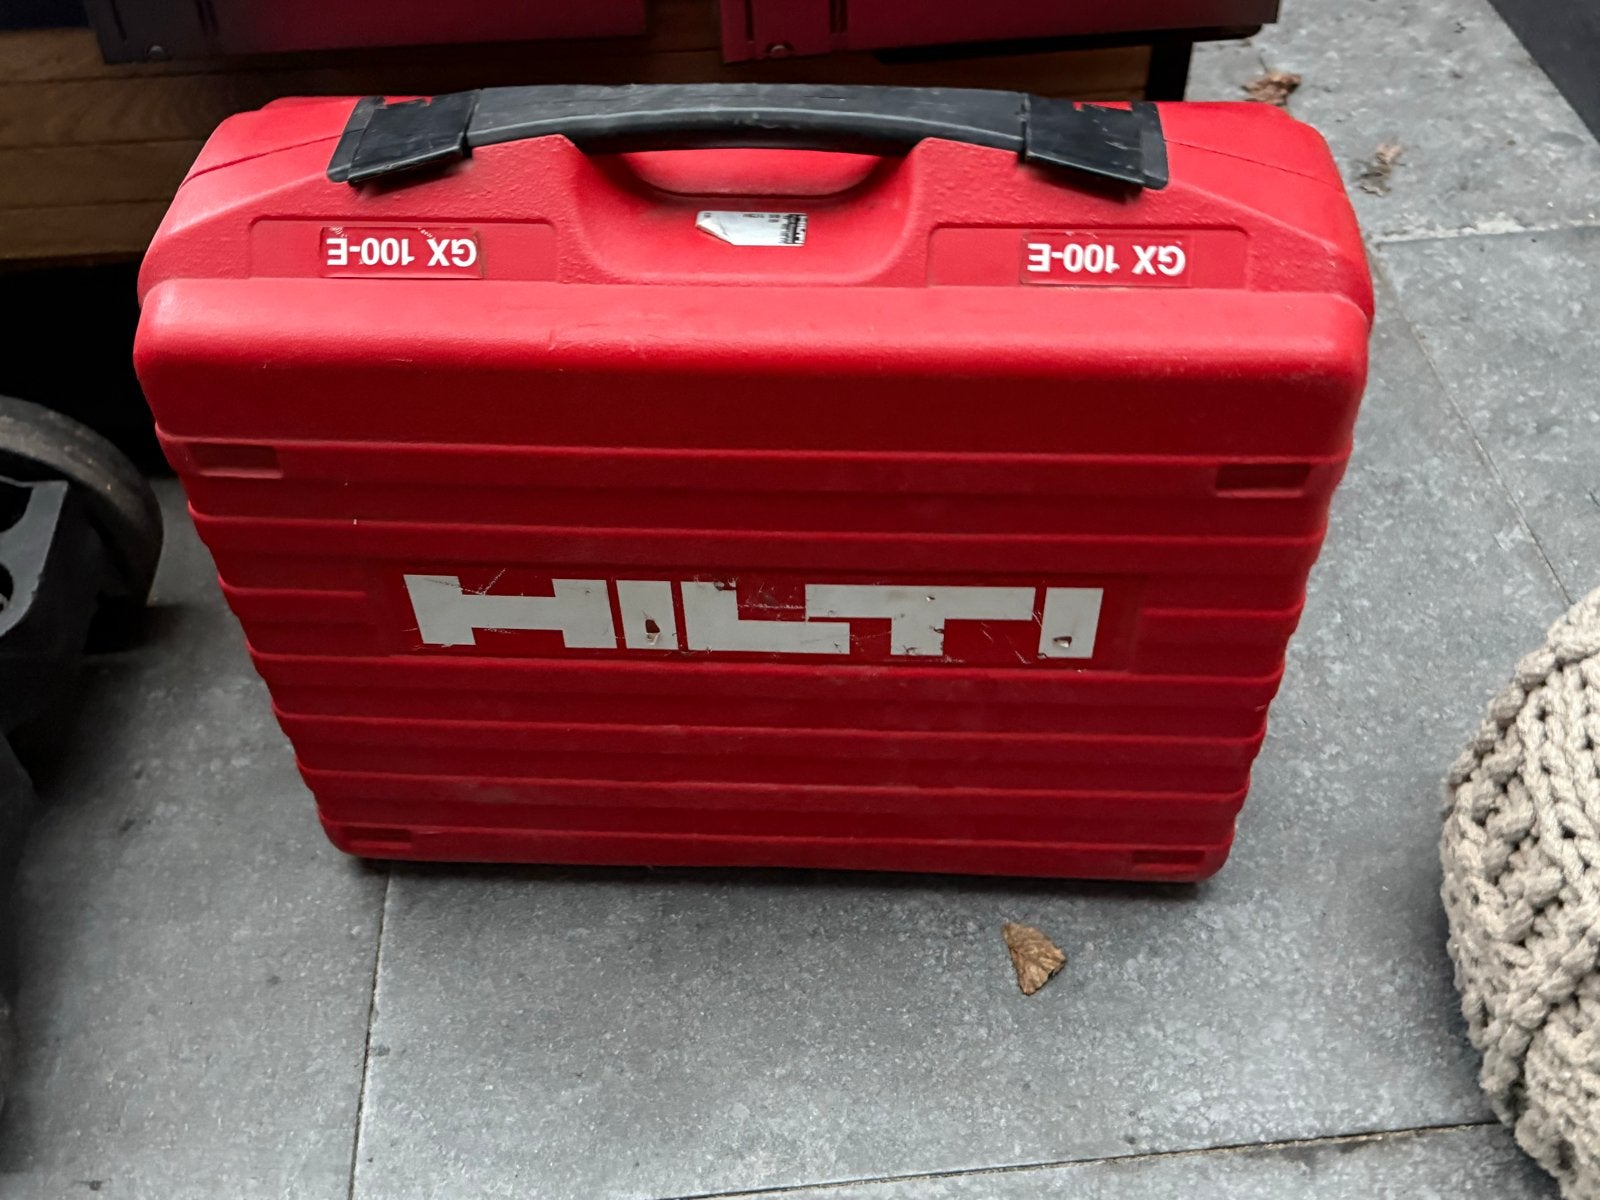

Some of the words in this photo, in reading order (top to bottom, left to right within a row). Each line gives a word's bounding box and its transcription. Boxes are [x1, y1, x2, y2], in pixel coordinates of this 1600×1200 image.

[326, 237, 415, 266] 100-E
[426, 238, 477, 267] GX
[1027, 243, 1120, 273] 100-E
[1131, 244, 1186, 276] GX
[403, 574, 1104, 659] HILTI
